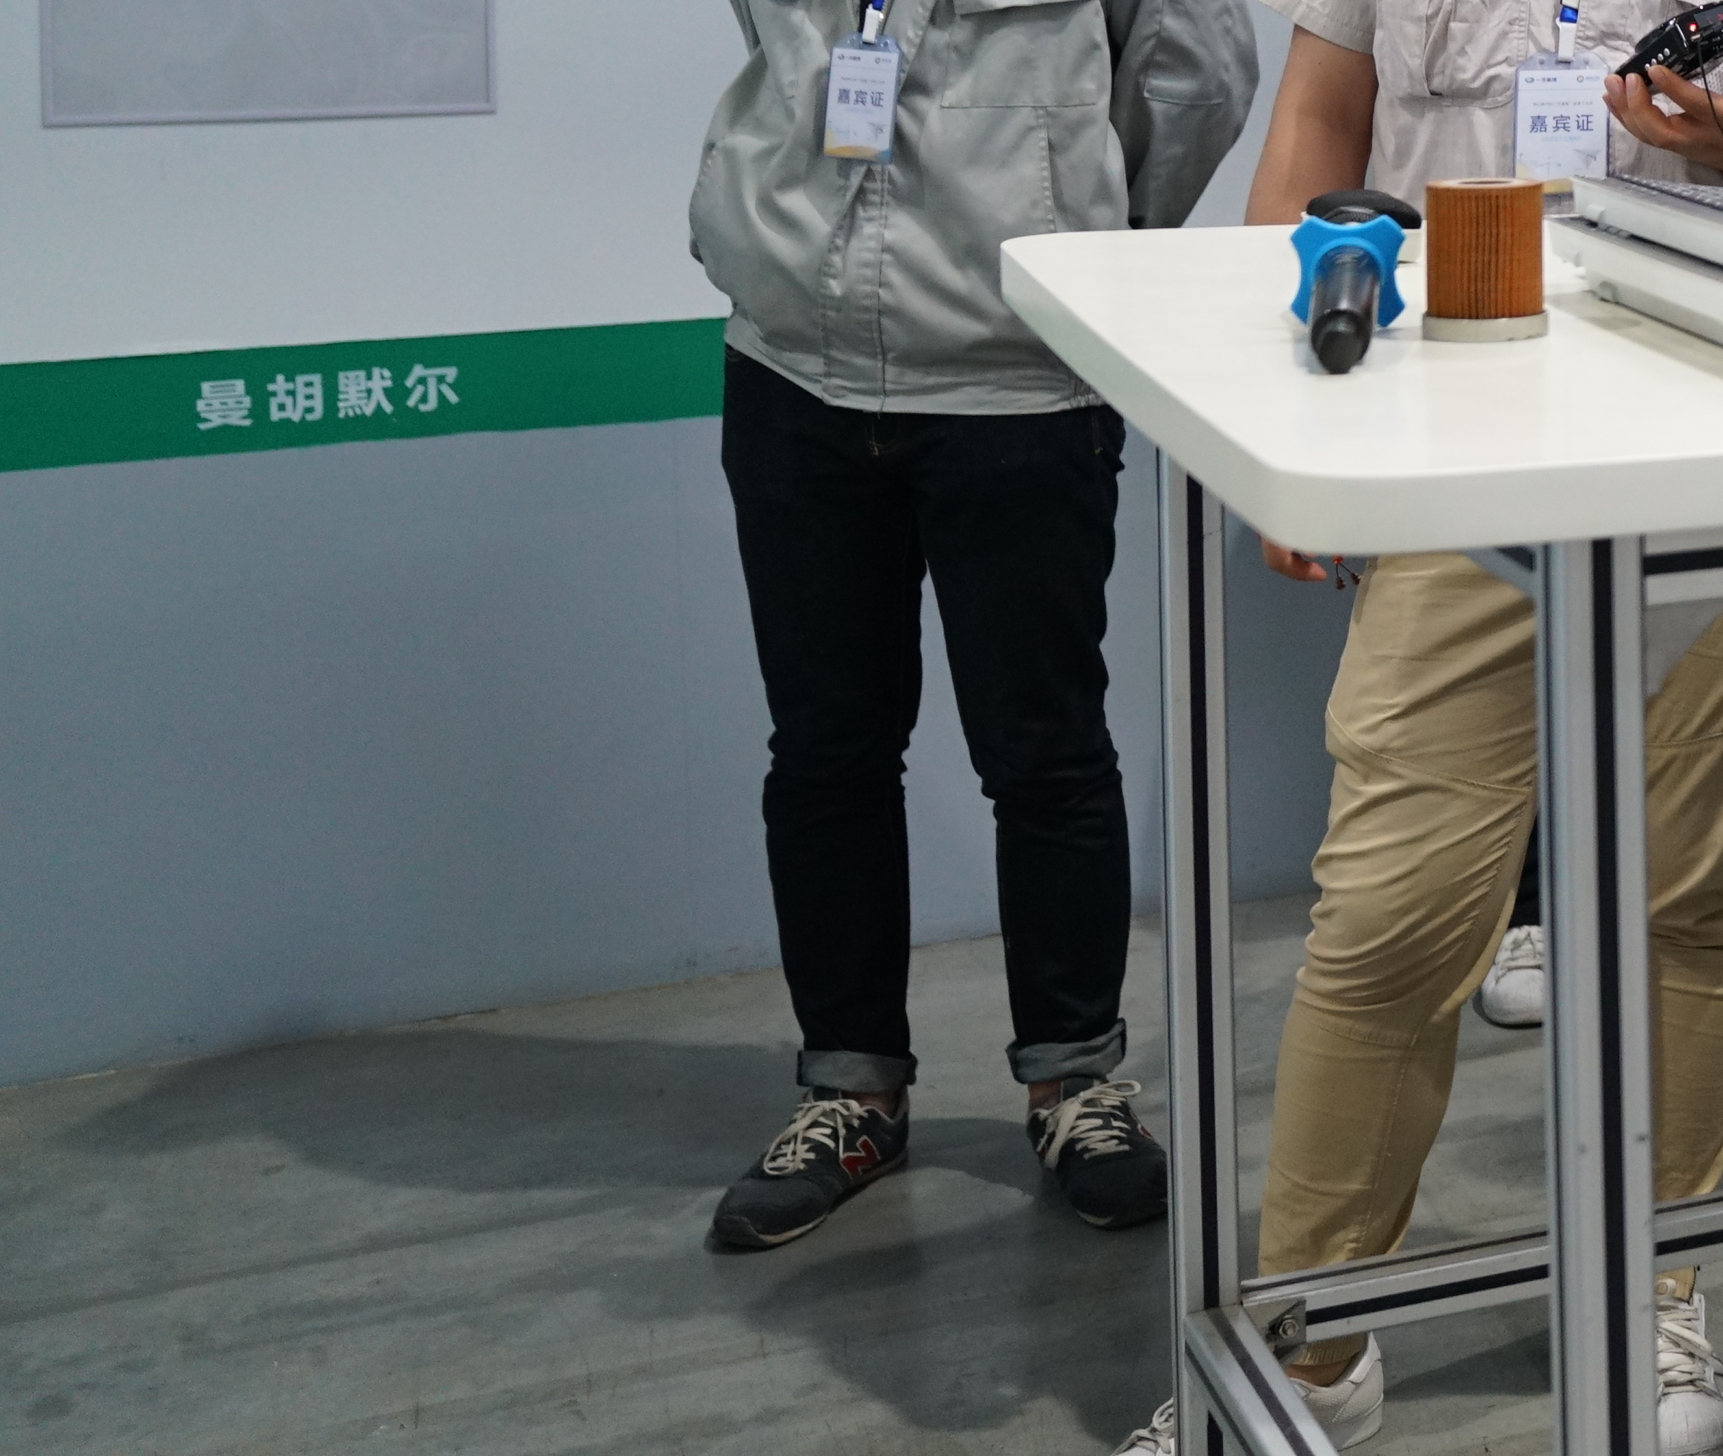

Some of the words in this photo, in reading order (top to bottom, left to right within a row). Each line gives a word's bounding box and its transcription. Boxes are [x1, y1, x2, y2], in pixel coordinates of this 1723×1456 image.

[837, 88, 885, 108] 嘉宾证
[1529, 114, 1594, 134] 嘉宾证
[195, 363, 461, 431] 曼胡默尔
